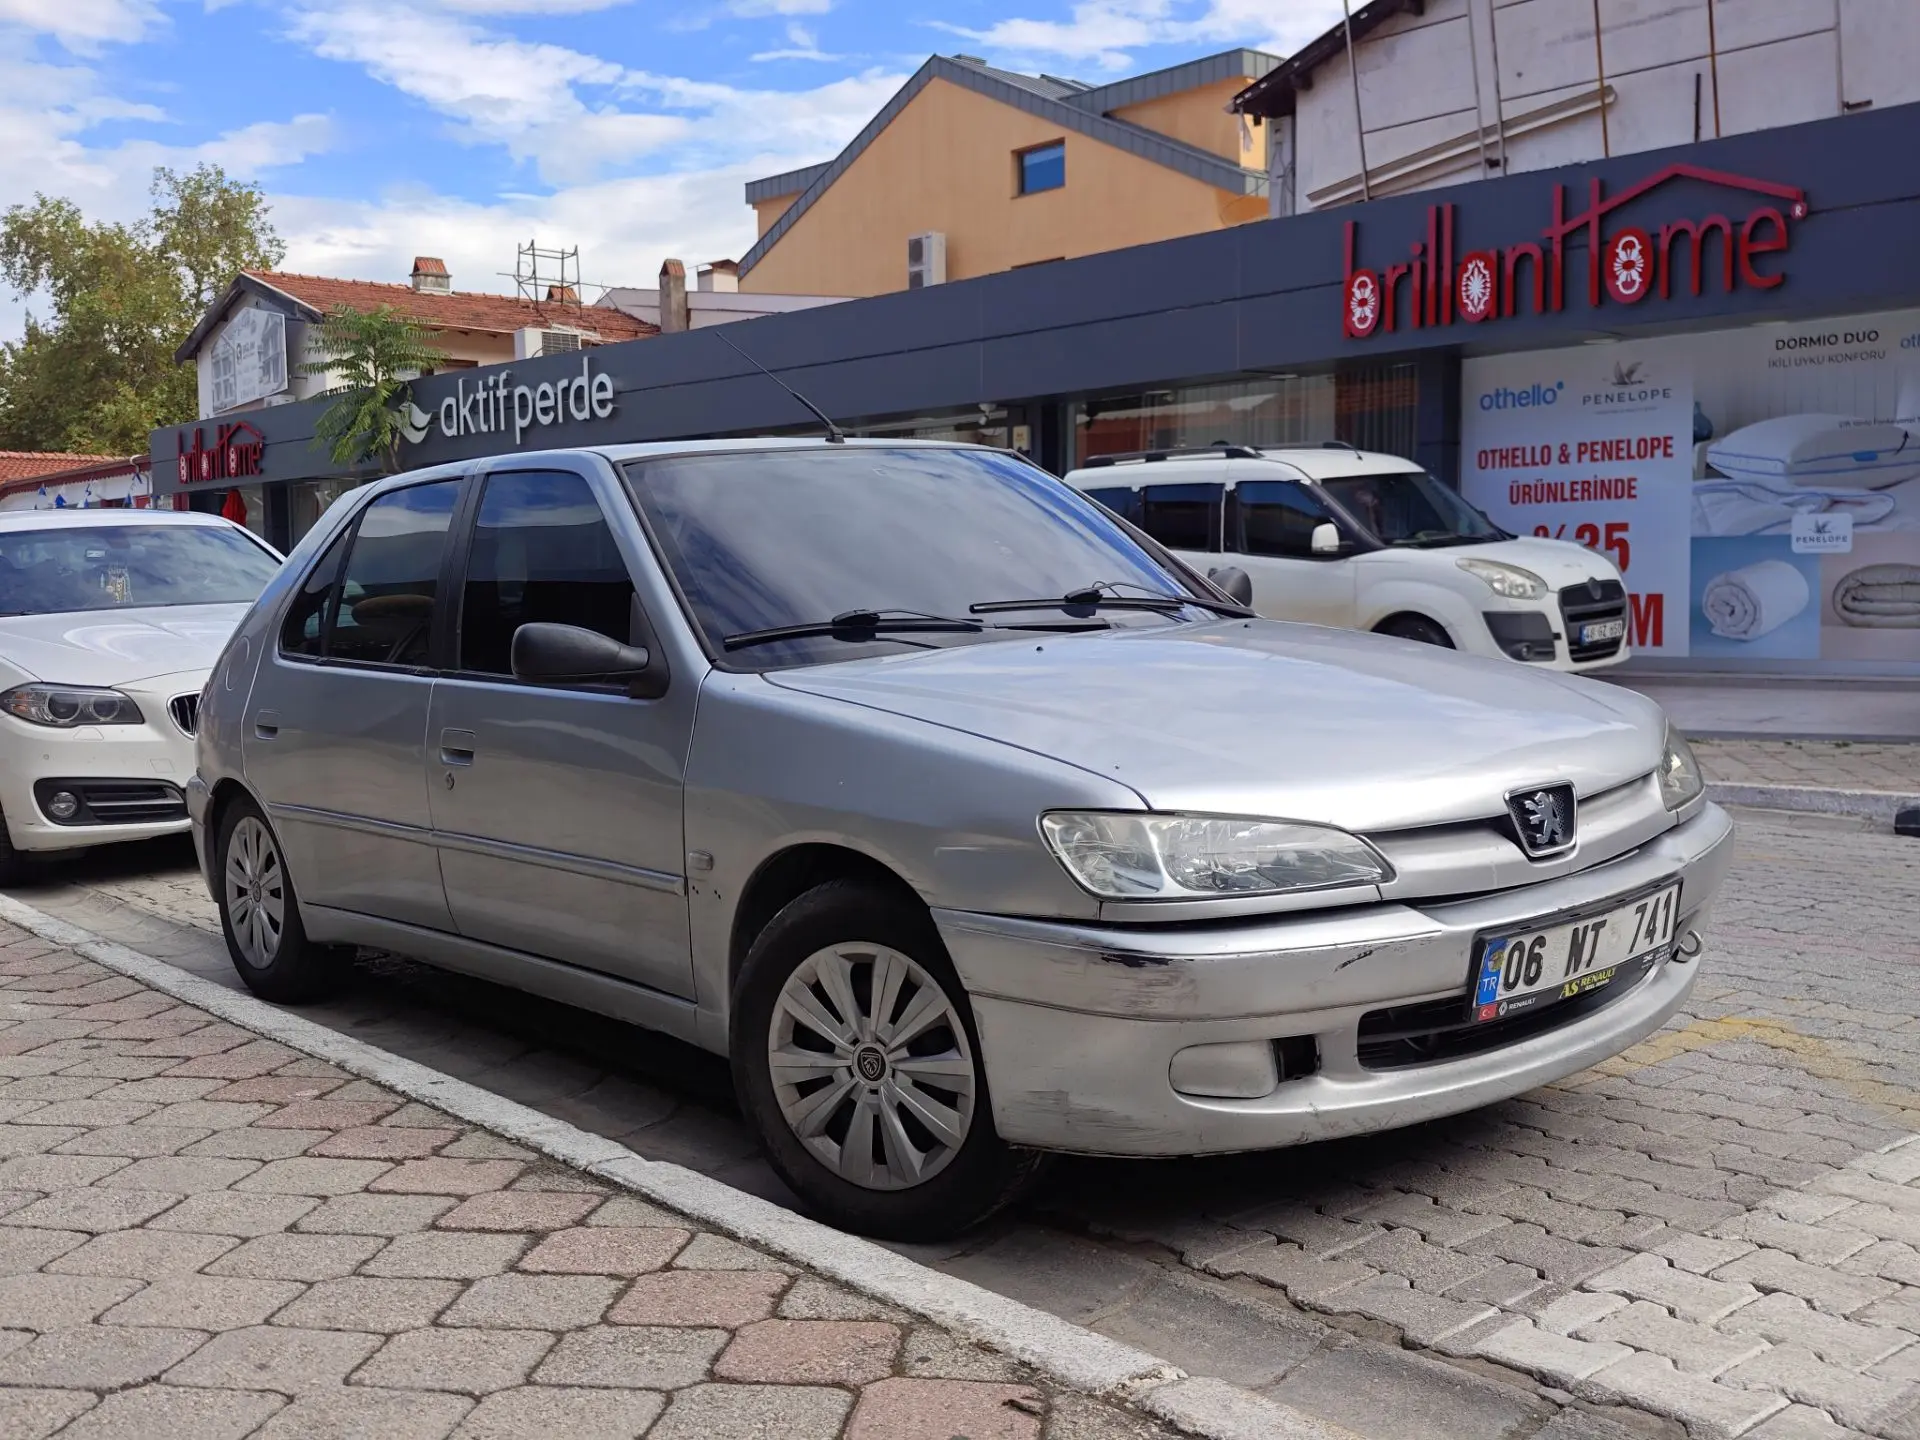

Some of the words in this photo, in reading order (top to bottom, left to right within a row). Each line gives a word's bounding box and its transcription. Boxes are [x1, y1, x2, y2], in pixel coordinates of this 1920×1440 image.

[1775, 334, 1838, 351] DORMIO
[1843, 330, 1879, 344] DUO
[1794, 354, 1825, 367] UYKU
[1828, 350, 1886, 364] KONFORU
[1480, 383, 1557, 411] othello
[1582, 388, 1672, 406] PENELOPE
[1477, 444, 1552, 470] OTHELLO
[1558, 443, 1570, 464] &
[1577, 436, 1674, 463] PENELOPE
[1509, 474, 1638, 505] ÜRÜNLERİNDE
[1503, 935, 1547, 991] 06
[1564, 919, 1607, 977] NT
[1628, 891, 1673, 954] 741
[1482, 976, 1497, 992] TR
[1559, 980, 1580, 1000] AS
[1580, 966, 1616, 987] RENAULT
[1508, 997, 1537, 1011] RENAULT
